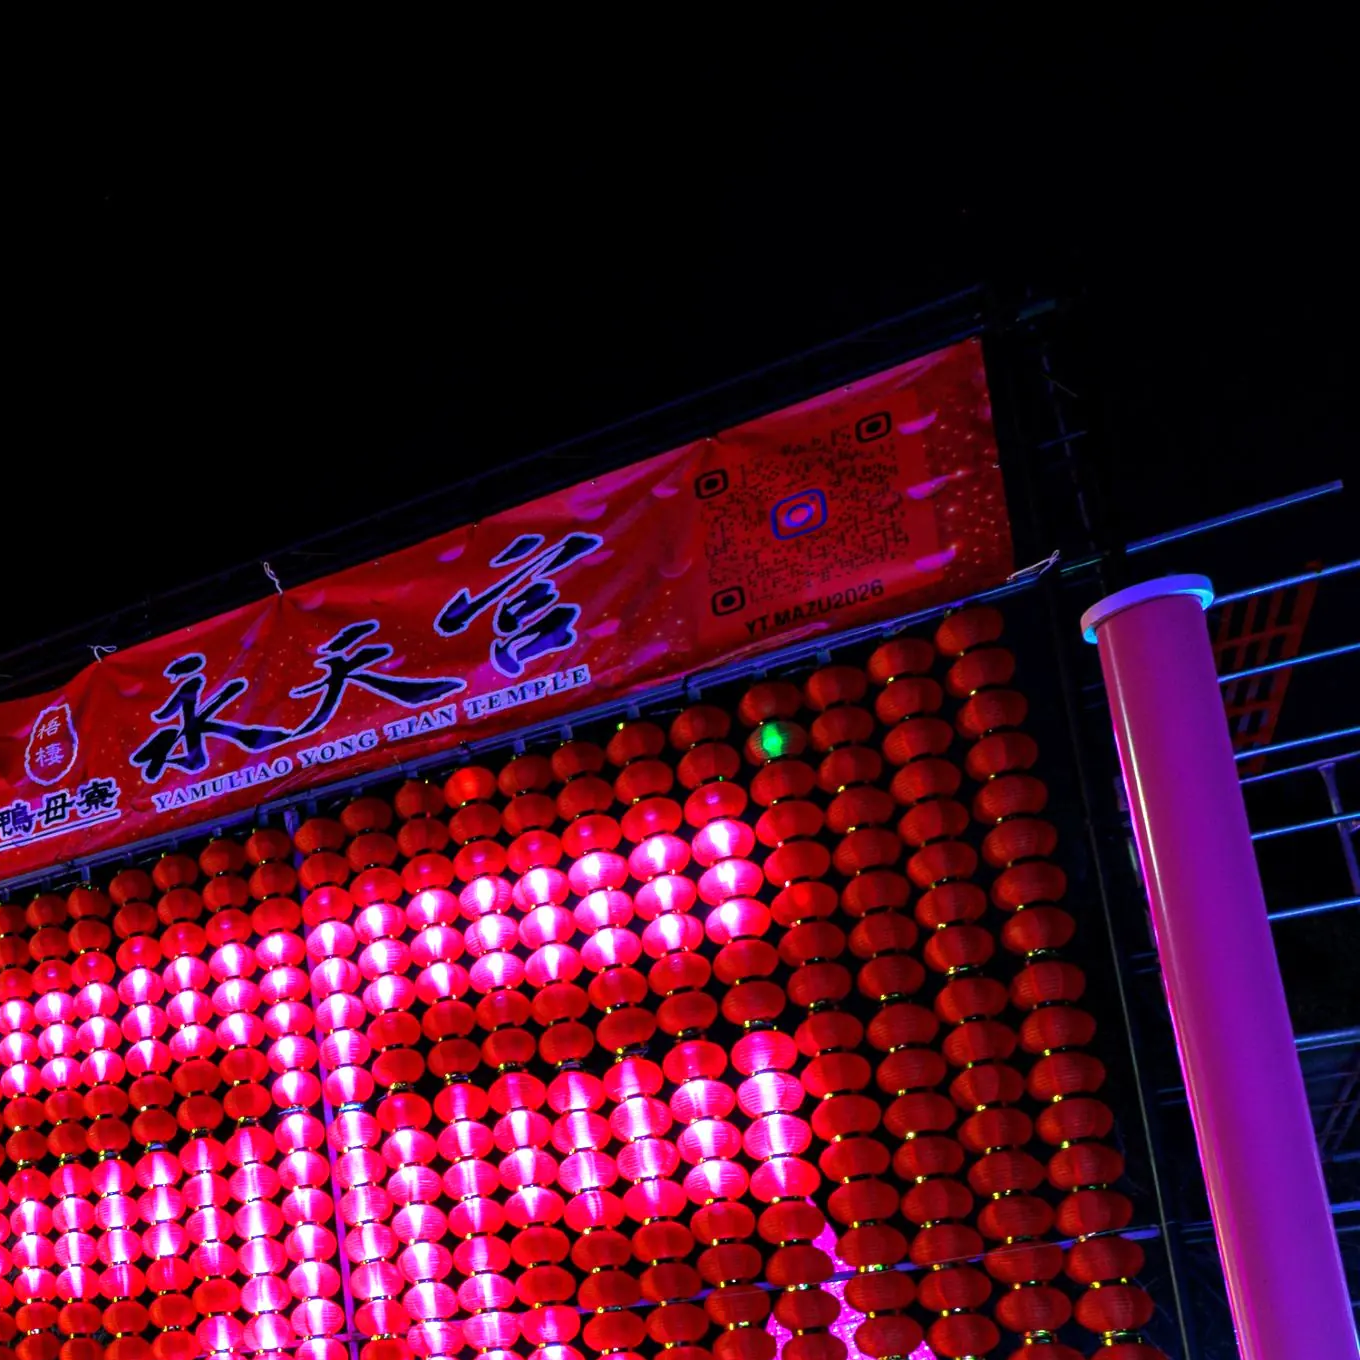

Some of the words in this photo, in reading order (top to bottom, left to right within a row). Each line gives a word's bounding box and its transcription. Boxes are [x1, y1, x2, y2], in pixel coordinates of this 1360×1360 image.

[129, 532, 603, 783] 永天宮
[35, 716, 65, 767] 梧棲
[152, 754, 294, 813] YAMULIAO
[298, 728, 379, 769] YONG
[384, 704, 458, 741] TIAN
[464, 665, 592, 719] TEMPLE
